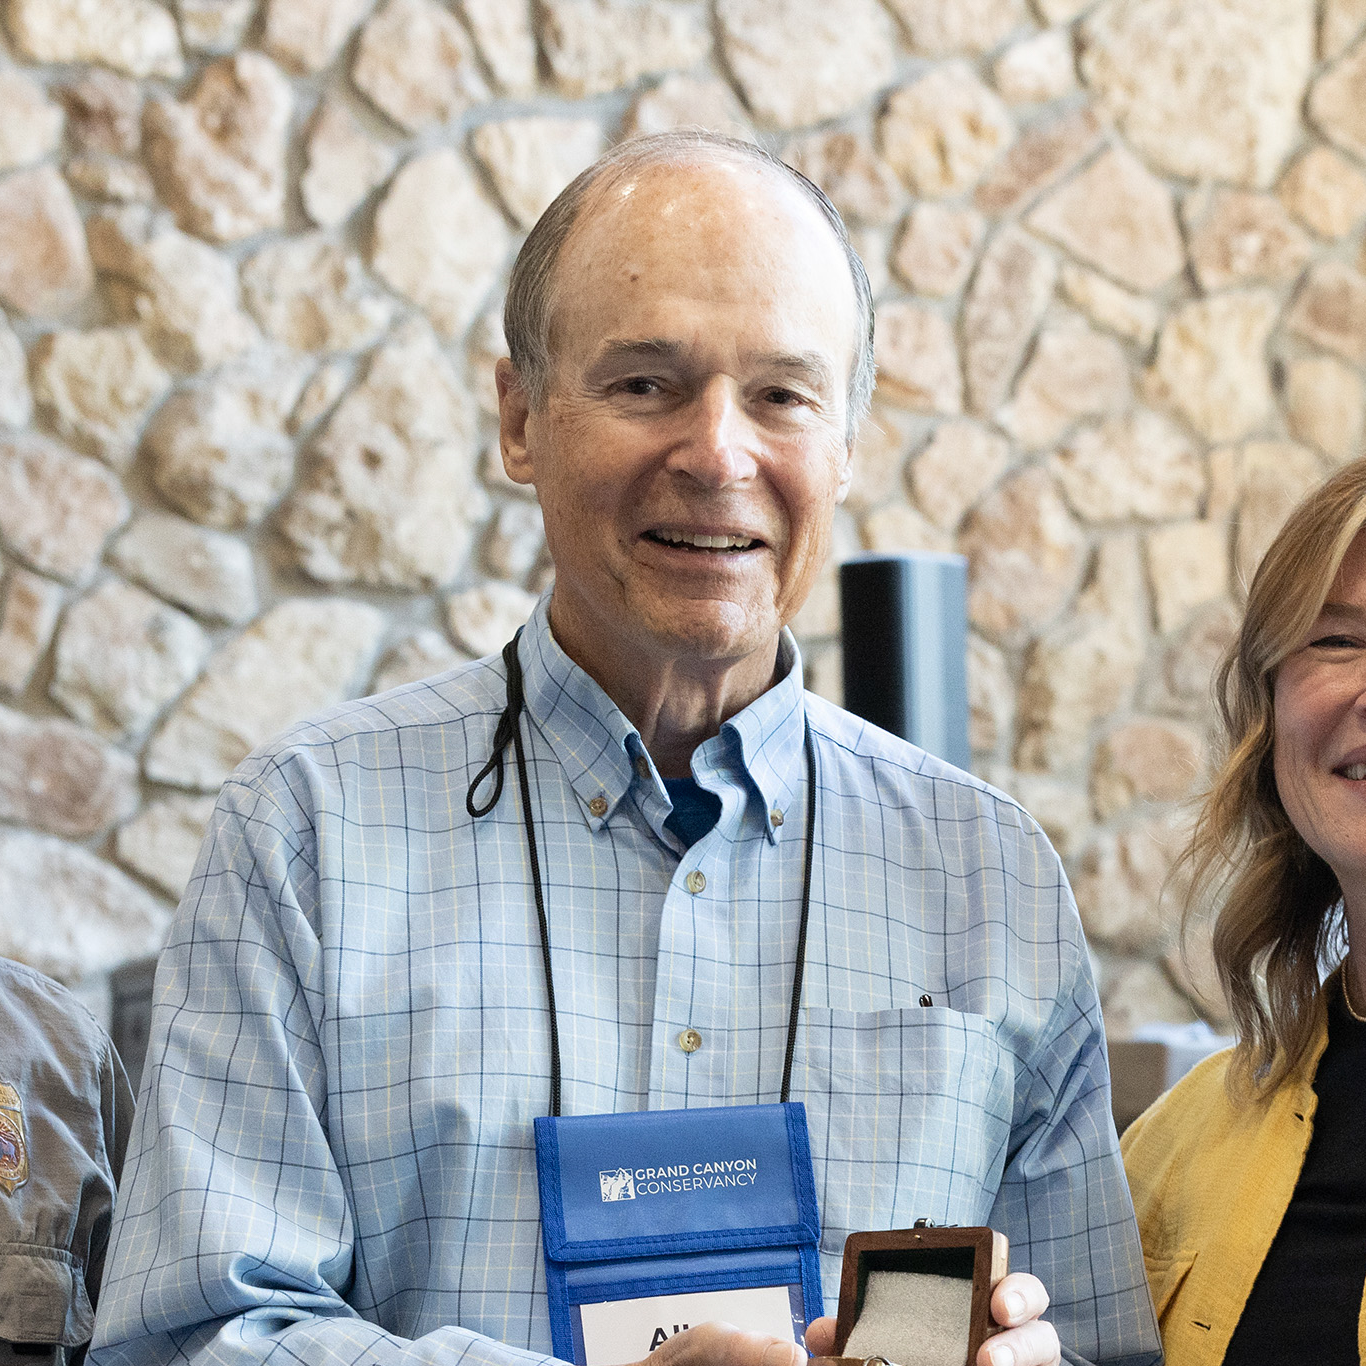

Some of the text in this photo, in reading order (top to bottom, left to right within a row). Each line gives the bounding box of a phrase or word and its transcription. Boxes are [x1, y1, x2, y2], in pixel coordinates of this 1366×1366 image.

[635, 1158, 757, 1181] GRAND CANYON
[636, 1172, 758, 1196] CONSERVANCY
